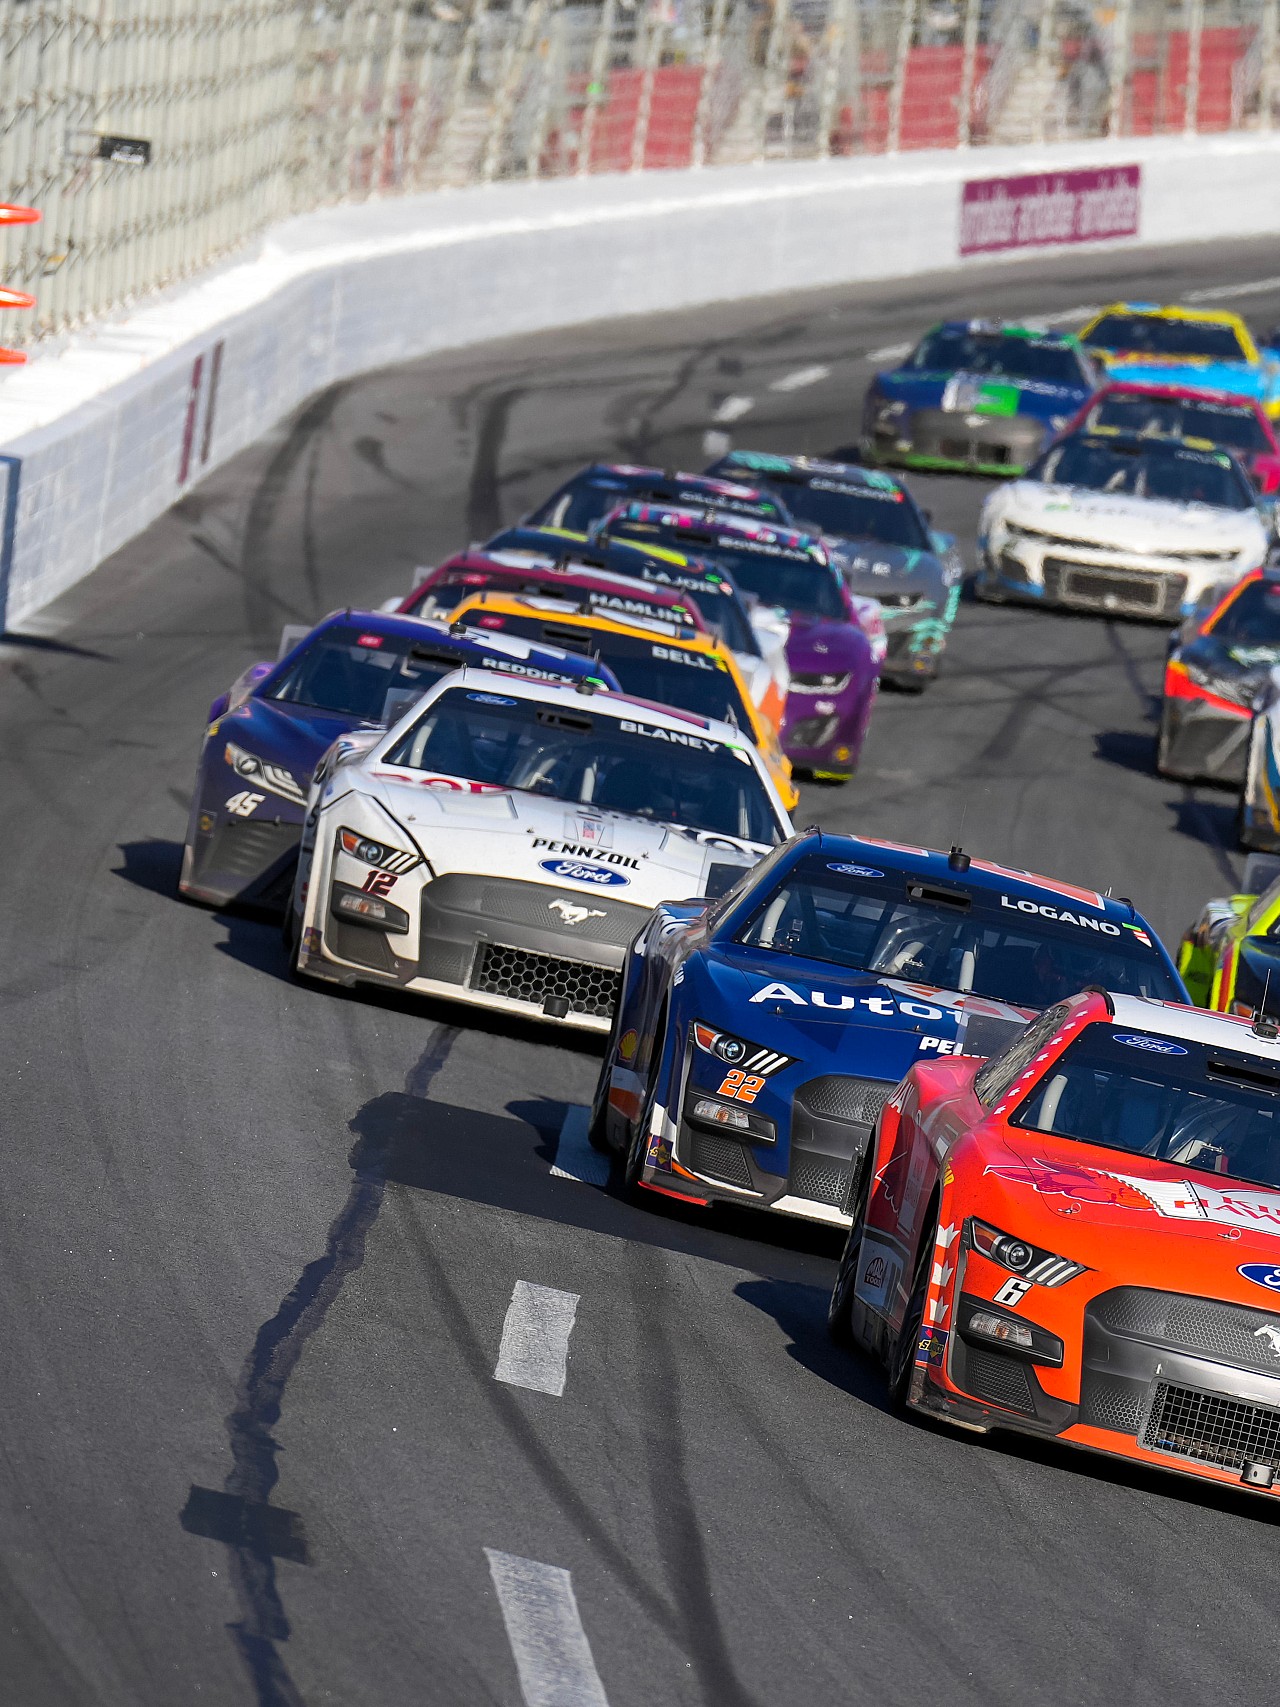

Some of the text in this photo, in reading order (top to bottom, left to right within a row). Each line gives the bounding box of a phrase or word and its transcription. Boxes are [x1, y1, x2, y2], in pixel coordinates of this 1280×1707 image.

[589, 592, 683, 625] HAMLIN
[482, 656, 574, 685] REDDICK
[652, 645, 713, 672] BELL
[620, 719, 721, 754] BLANEY
[224, 791, 267, 818] 45
[531, 836, 642, 872] PENNZOIL
[361, 869, 399, 896] 12
[553, 858, 615, 887] Ford
[1001, 894, 1122, 937] LOGANO
[717, 1068, 766, 1103] 22
[993, 1276, 1033, 1308] 6
